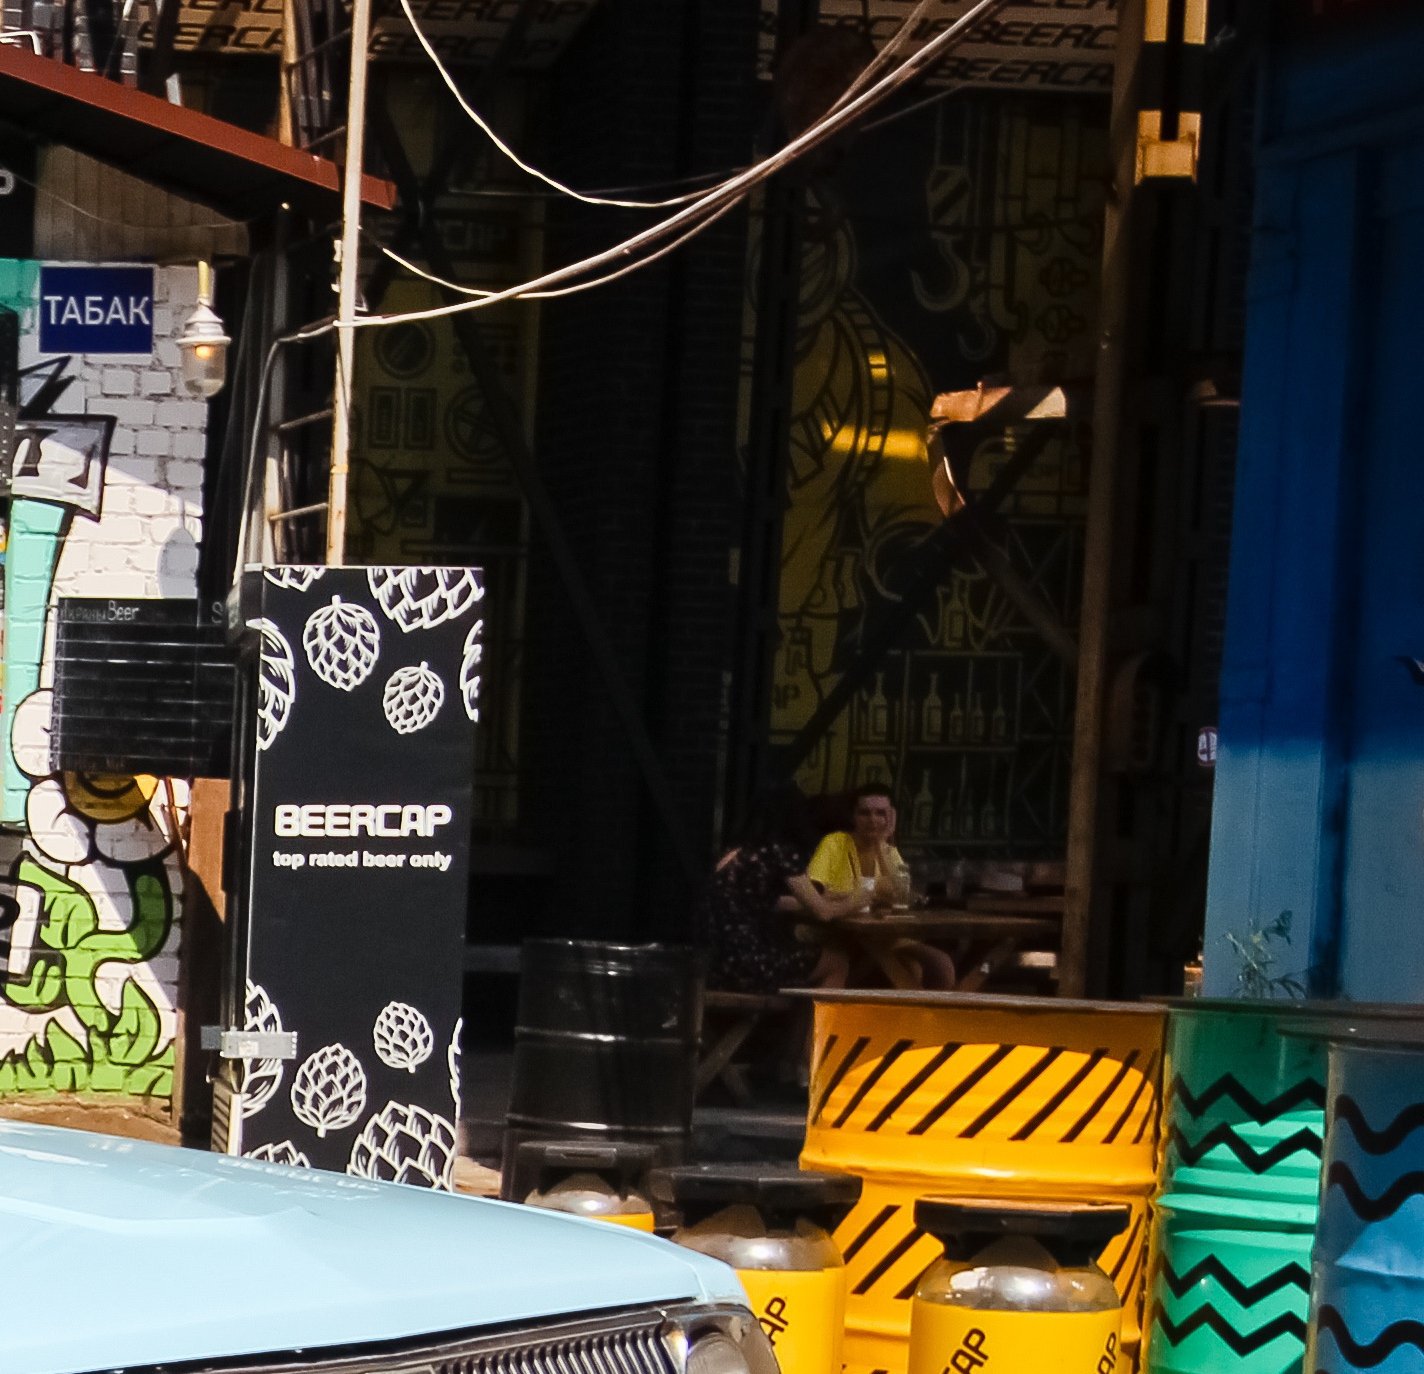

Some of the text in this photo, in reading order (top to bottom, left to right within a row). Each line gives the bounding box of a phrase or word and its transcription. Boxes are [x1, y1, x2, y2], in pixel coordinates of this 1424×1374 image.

[961, 20, 1119, 49] BEERC
[924, 56, 1115, 86] BEERCA
[43, 295, 151, 325] ТАБАК
[107, 600, 140, 622] Beer
[274, 803, 453, 838] BEERCAP
[272, 849, 453, 873] top rated beer only
